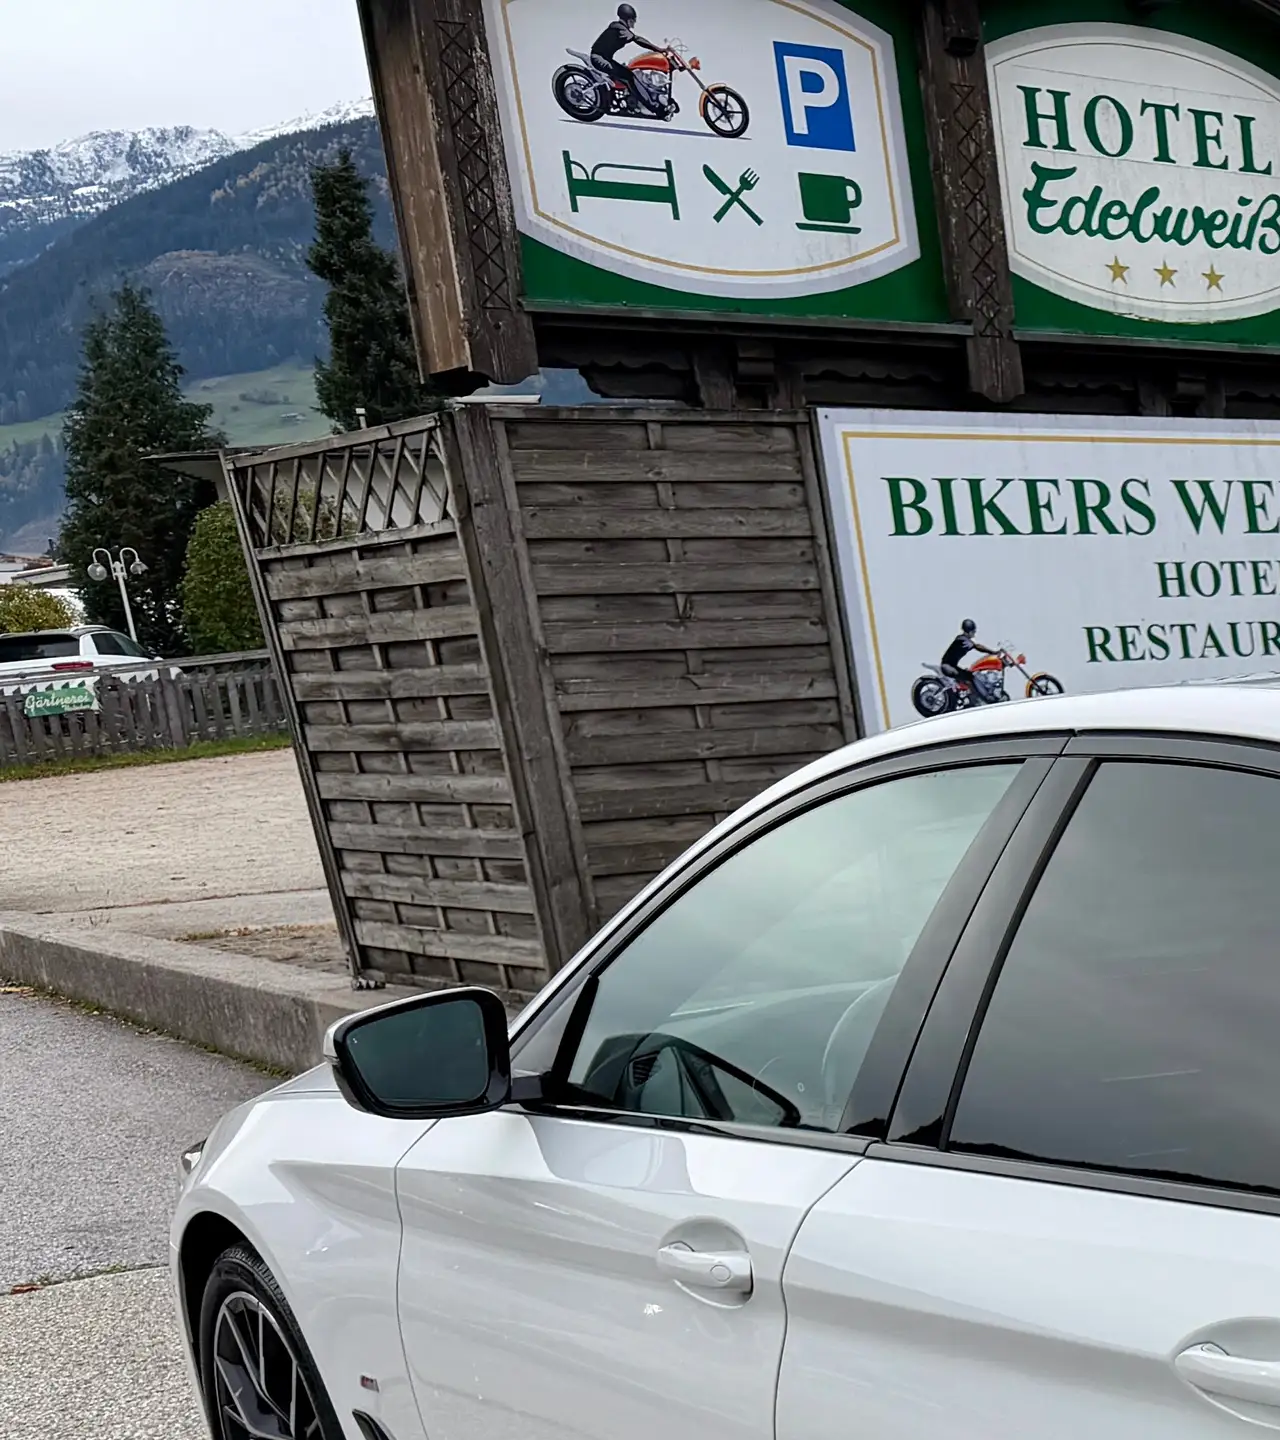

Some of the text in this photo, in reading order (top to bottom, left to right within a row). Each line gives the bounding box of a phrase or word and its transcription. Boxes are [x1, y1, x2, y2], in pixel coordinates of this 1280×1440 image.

[783, 55, 840, 135] P
[1017, 84, 1274, 177] HOTEL
[881, 477, 1157, 537] BIKERS
